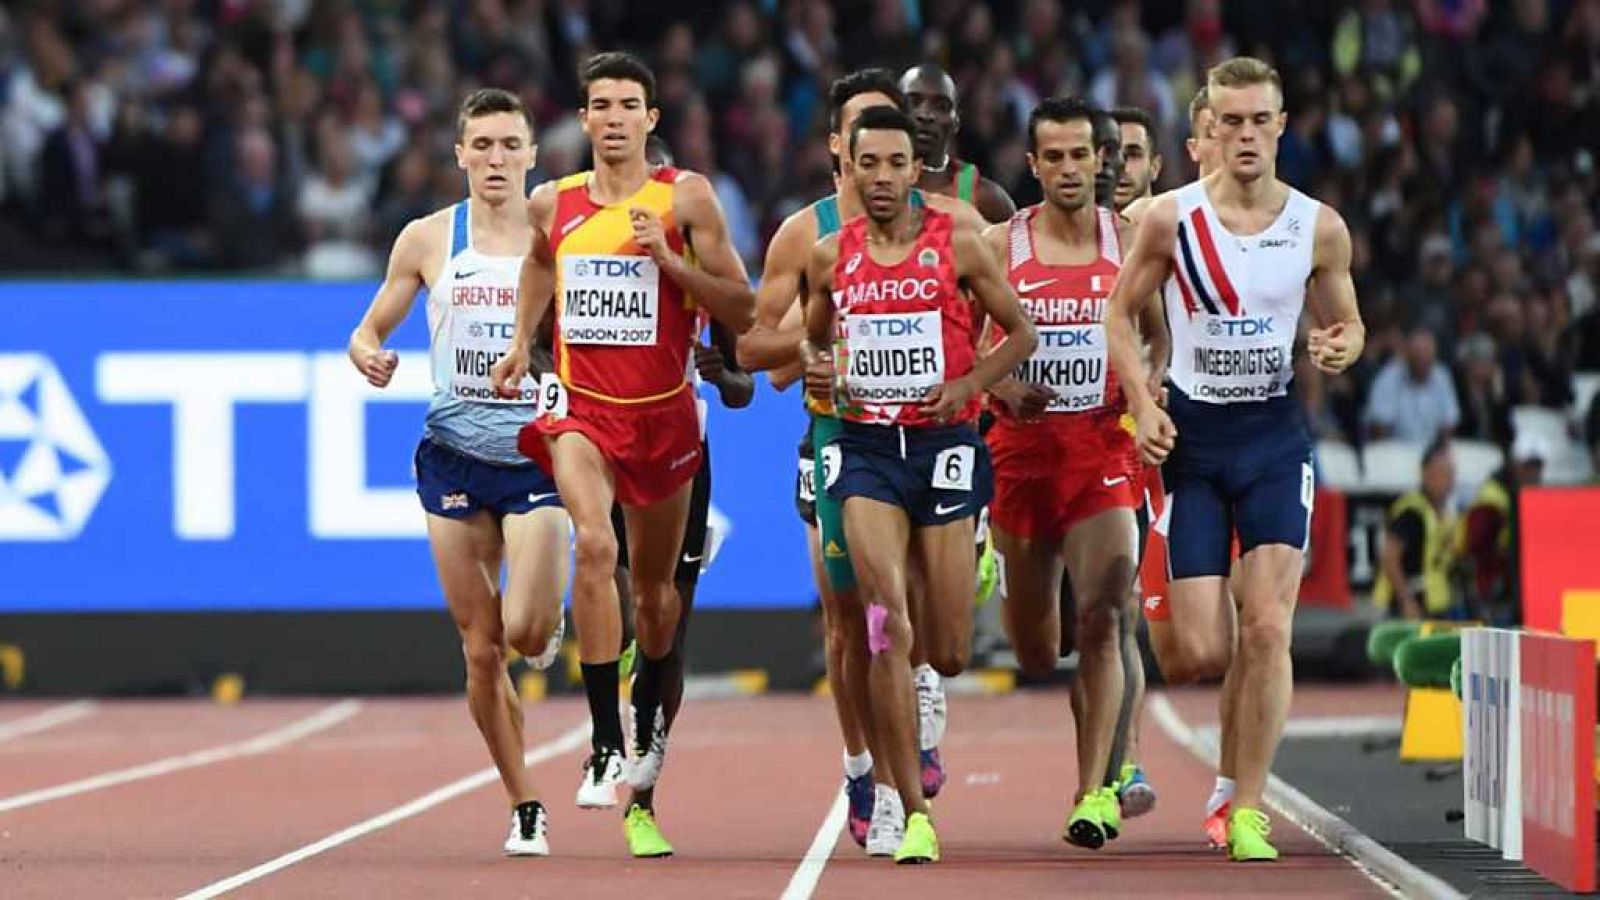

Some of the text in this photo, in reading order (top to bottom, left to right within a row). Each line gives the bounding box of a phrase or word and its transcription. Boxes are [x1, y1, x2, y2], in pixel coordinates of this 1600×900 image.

[588, 260, 642, 278] TDK
[452, 287, 495, 306] GREAT
[848, 278, 938, 304] MAROC
[565, 289, 652, 319] MECHAAL
[483, 323, 515, 339] TD
[620, 330, 652, 341] 2017
[872, 317, 924, 336] TDK
[1222, 317, 1273, 336] TDK
[1040, 330, 1093, 347] TDK
[1012, 358, 1101, 386] MIKHOU
[545, 383, 559, 410] 9
[1194, 384, 1256, 398] LONDON
[944, 454, 962, 482] 6
